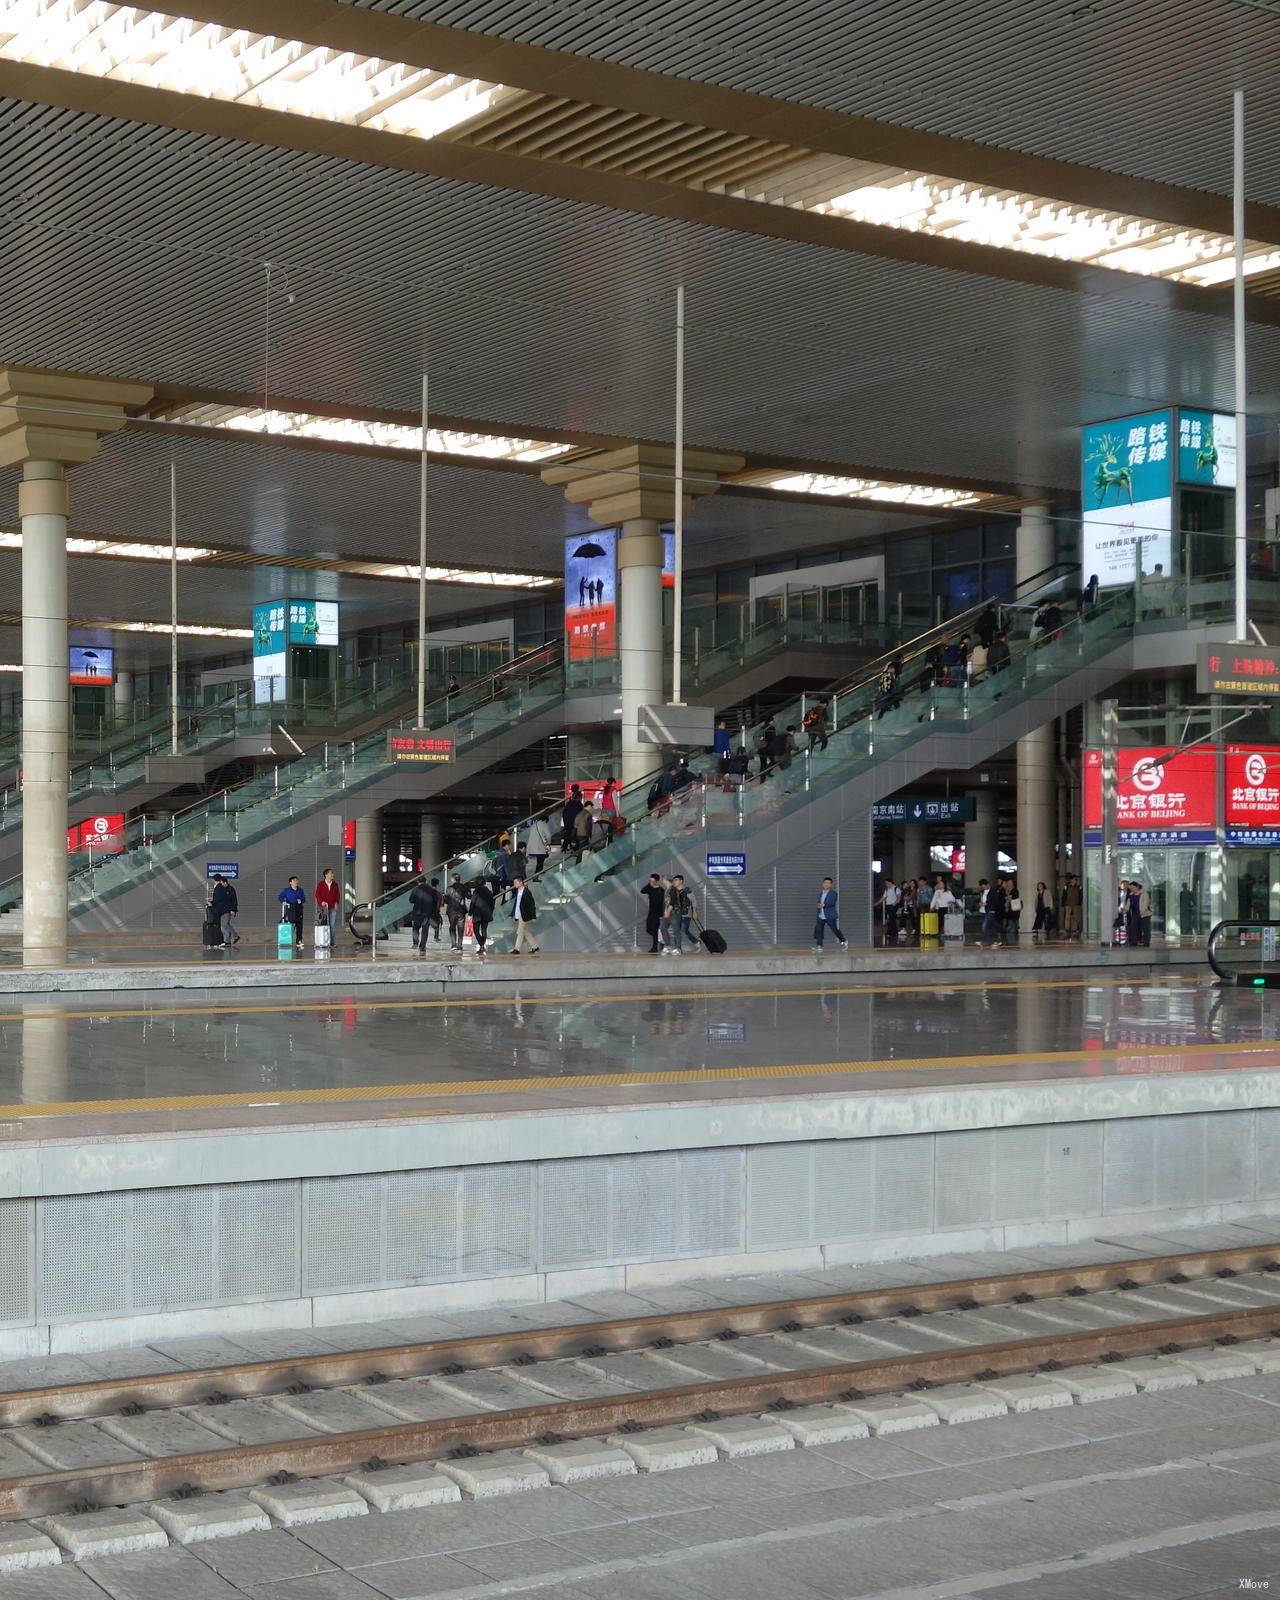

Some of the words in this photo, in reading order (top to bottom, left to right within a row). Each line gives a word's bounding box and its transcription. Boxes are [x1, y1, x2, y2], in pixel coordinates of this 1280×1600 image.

[1232, 787, 1279, 803] 北京银行
[1116, 793, 1187, 810] 北京银行
[1232, 802, 1249, 810] BANK
[1248, 802, 1257, 811] OF
[940, 803, 960, 813] 出站
[1117, 810, 1136, 819] ANK
[1137, 810, 1148, 818] OF
[1151, 809, 1186, 819] BEIJING
